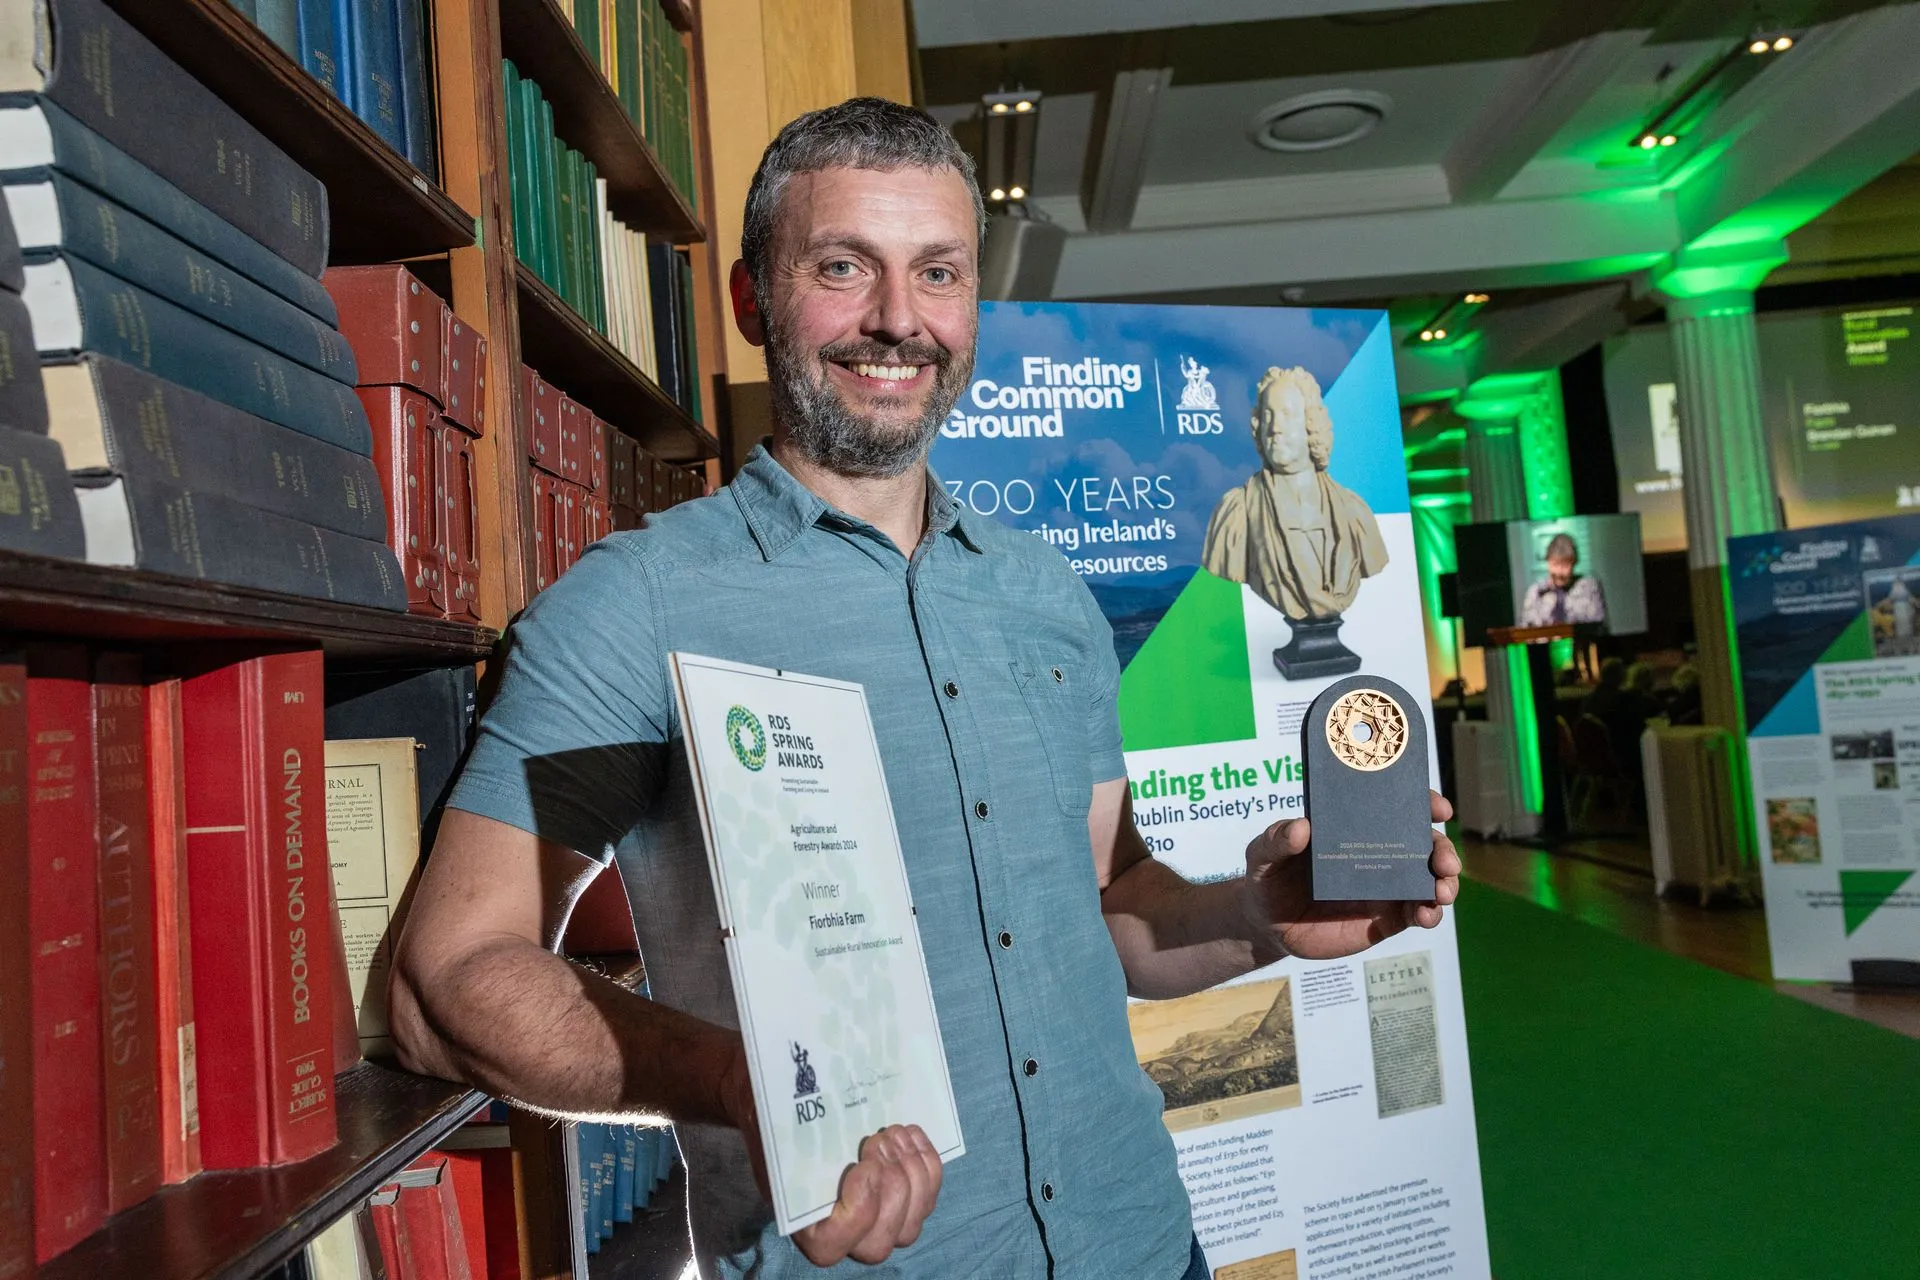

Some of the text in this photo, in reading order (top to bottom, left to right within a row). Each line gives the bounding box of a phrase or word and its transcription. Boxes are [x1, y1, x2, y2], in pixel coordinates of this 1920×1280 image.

[1023, 356, 1142, 392] Finding
[971, 379, 1125, 410] Common
[940, 408, 1064, 438] Ground
[1177, 412, 1224, 435] RDS
[1054, 475, 1175, 513] YEARS
[1083, 517, 1176, 544] Ireland's
[1065, 555, 1168, 575] esources
[767, 714, 791, 731] RDS
[772, 733, 814, 751] SPRING
[777, 752, 824, 770] AWARDS
[1210, 762, 1258, 790] the
[1263, 755, 1304, 786] Vis
[328, 777, 364, 789] RNAL
[790, 824, 838, 837] Agriculture and
[793, 840, 858, 853] Forestry Awards 2024
[1145, 836, 1174, 853] 810
[283, 747, 309, 1025] BOOKS ON DEMAND
[802, 882, 840, 900] Winner
[809, 912, 866, 930] Fiorbhia Farm
[102, 814, 141, 1067] AUTHORS
[1369, 966, 1423, 984] LETTER
[291, 1074, 321, 1096] GUIDE
[288, 1089, 326, 1114] SUBJECT
[795, 1096, 826, 1126] RDS
[1195, 1140, 1217, 1151] match
[1218, 1135, 1245, 1146] funding
[1246, 1128, 1273, 1140] Madden
[1188, 1156, 1213, 1167] annuity
[1250, 1144, 1269, 1154] every
[1225, 1158, 1259, 1173] stipulated
[1197, 1182, 1223, 1194] divided
[1191, 1196, 1225, 1210] griculture
[1227, 1191, 1240, 1200] and
[1244, 1202, 1256, 1210] the
[1303, 1205, 1316, 1214] The
[1316, 1199, 1340, 1211] Society
[1204, 1226, 1216, 1235] the
[1217, 1222, 1233, 1232] best
[1304, 1216, 1330, 1228] scheme
[1201, 1237, 1226, 1249] oduced
[1306, 1226, 1345, 1242] applications
